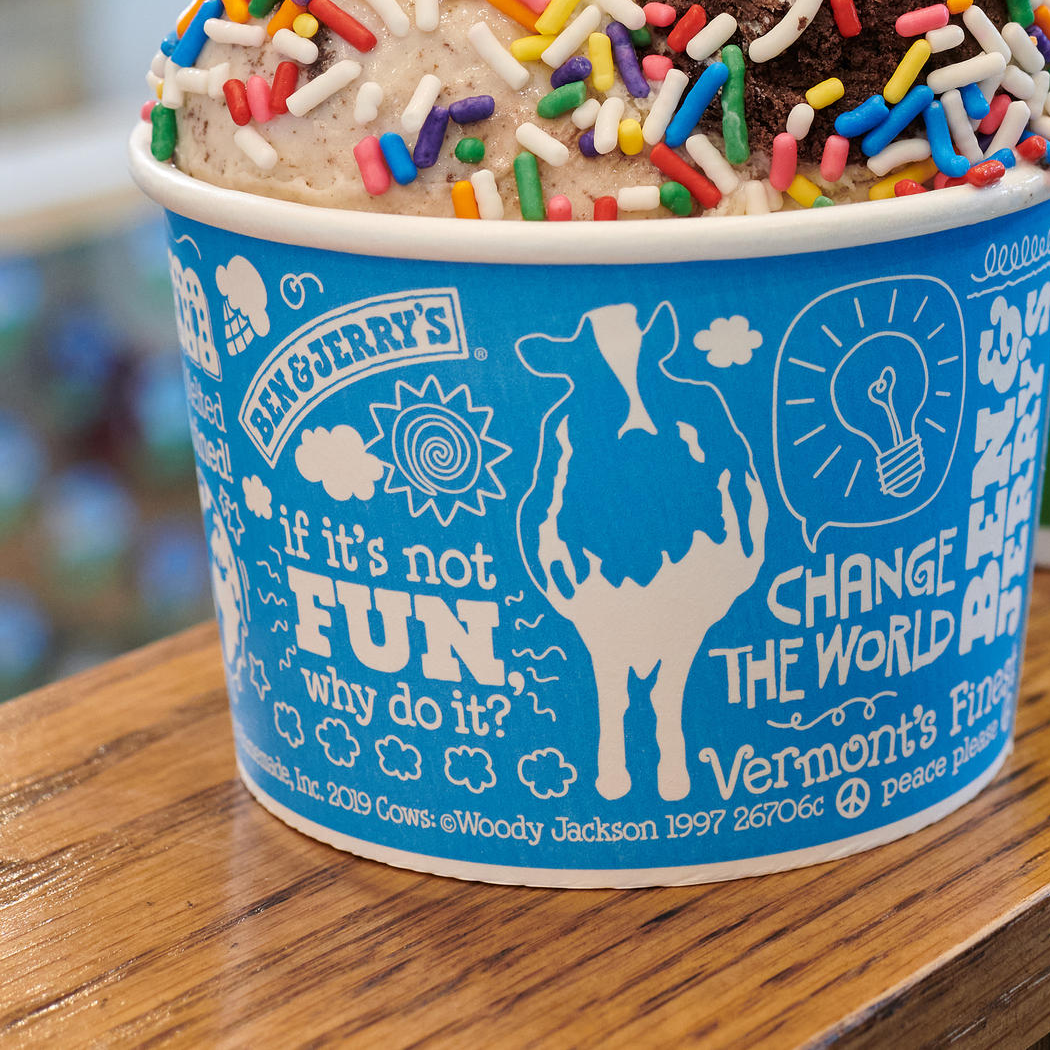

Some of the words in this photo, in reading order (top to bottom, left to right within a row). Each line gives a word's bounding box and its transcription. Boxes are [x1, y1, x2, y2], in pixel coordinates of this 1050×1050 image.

[249, 374, 301, 443] BEN
[291, 356, 315, 387] &
[308, 303, 453, 379] JERRY'S
[977, 295, 1024, 394] &
[279, 505, 311, 561] if
[321, 517, 389, 577] it's
[402, 542, 497, 590] not
[957, 397, 1016, 656] BEN
[767, 527, 958, 628] CHANGE
[287, 565, 525, 695] FUN,
[708, 637, 804, 708] THE
[815, 609, 956, 689] WORLD
[300, 665, 377, 727] why
[388, 681, 443, 731] do
[450, 689, 512, 738] it?
[294, 767, 325, 802] Inc.
[327, 781, 372, 816] 2019
[375, 795, 436, 830] Cows:
[551, 816, 659, 844] Jackson
[665, 809, 726, 839] 1997
[733, 793, 825, 832] 26706c
[881, 756, 947, 807] peace
[951, 719, 999, 776] please
[698, 704, 937, 801] Vermont's
